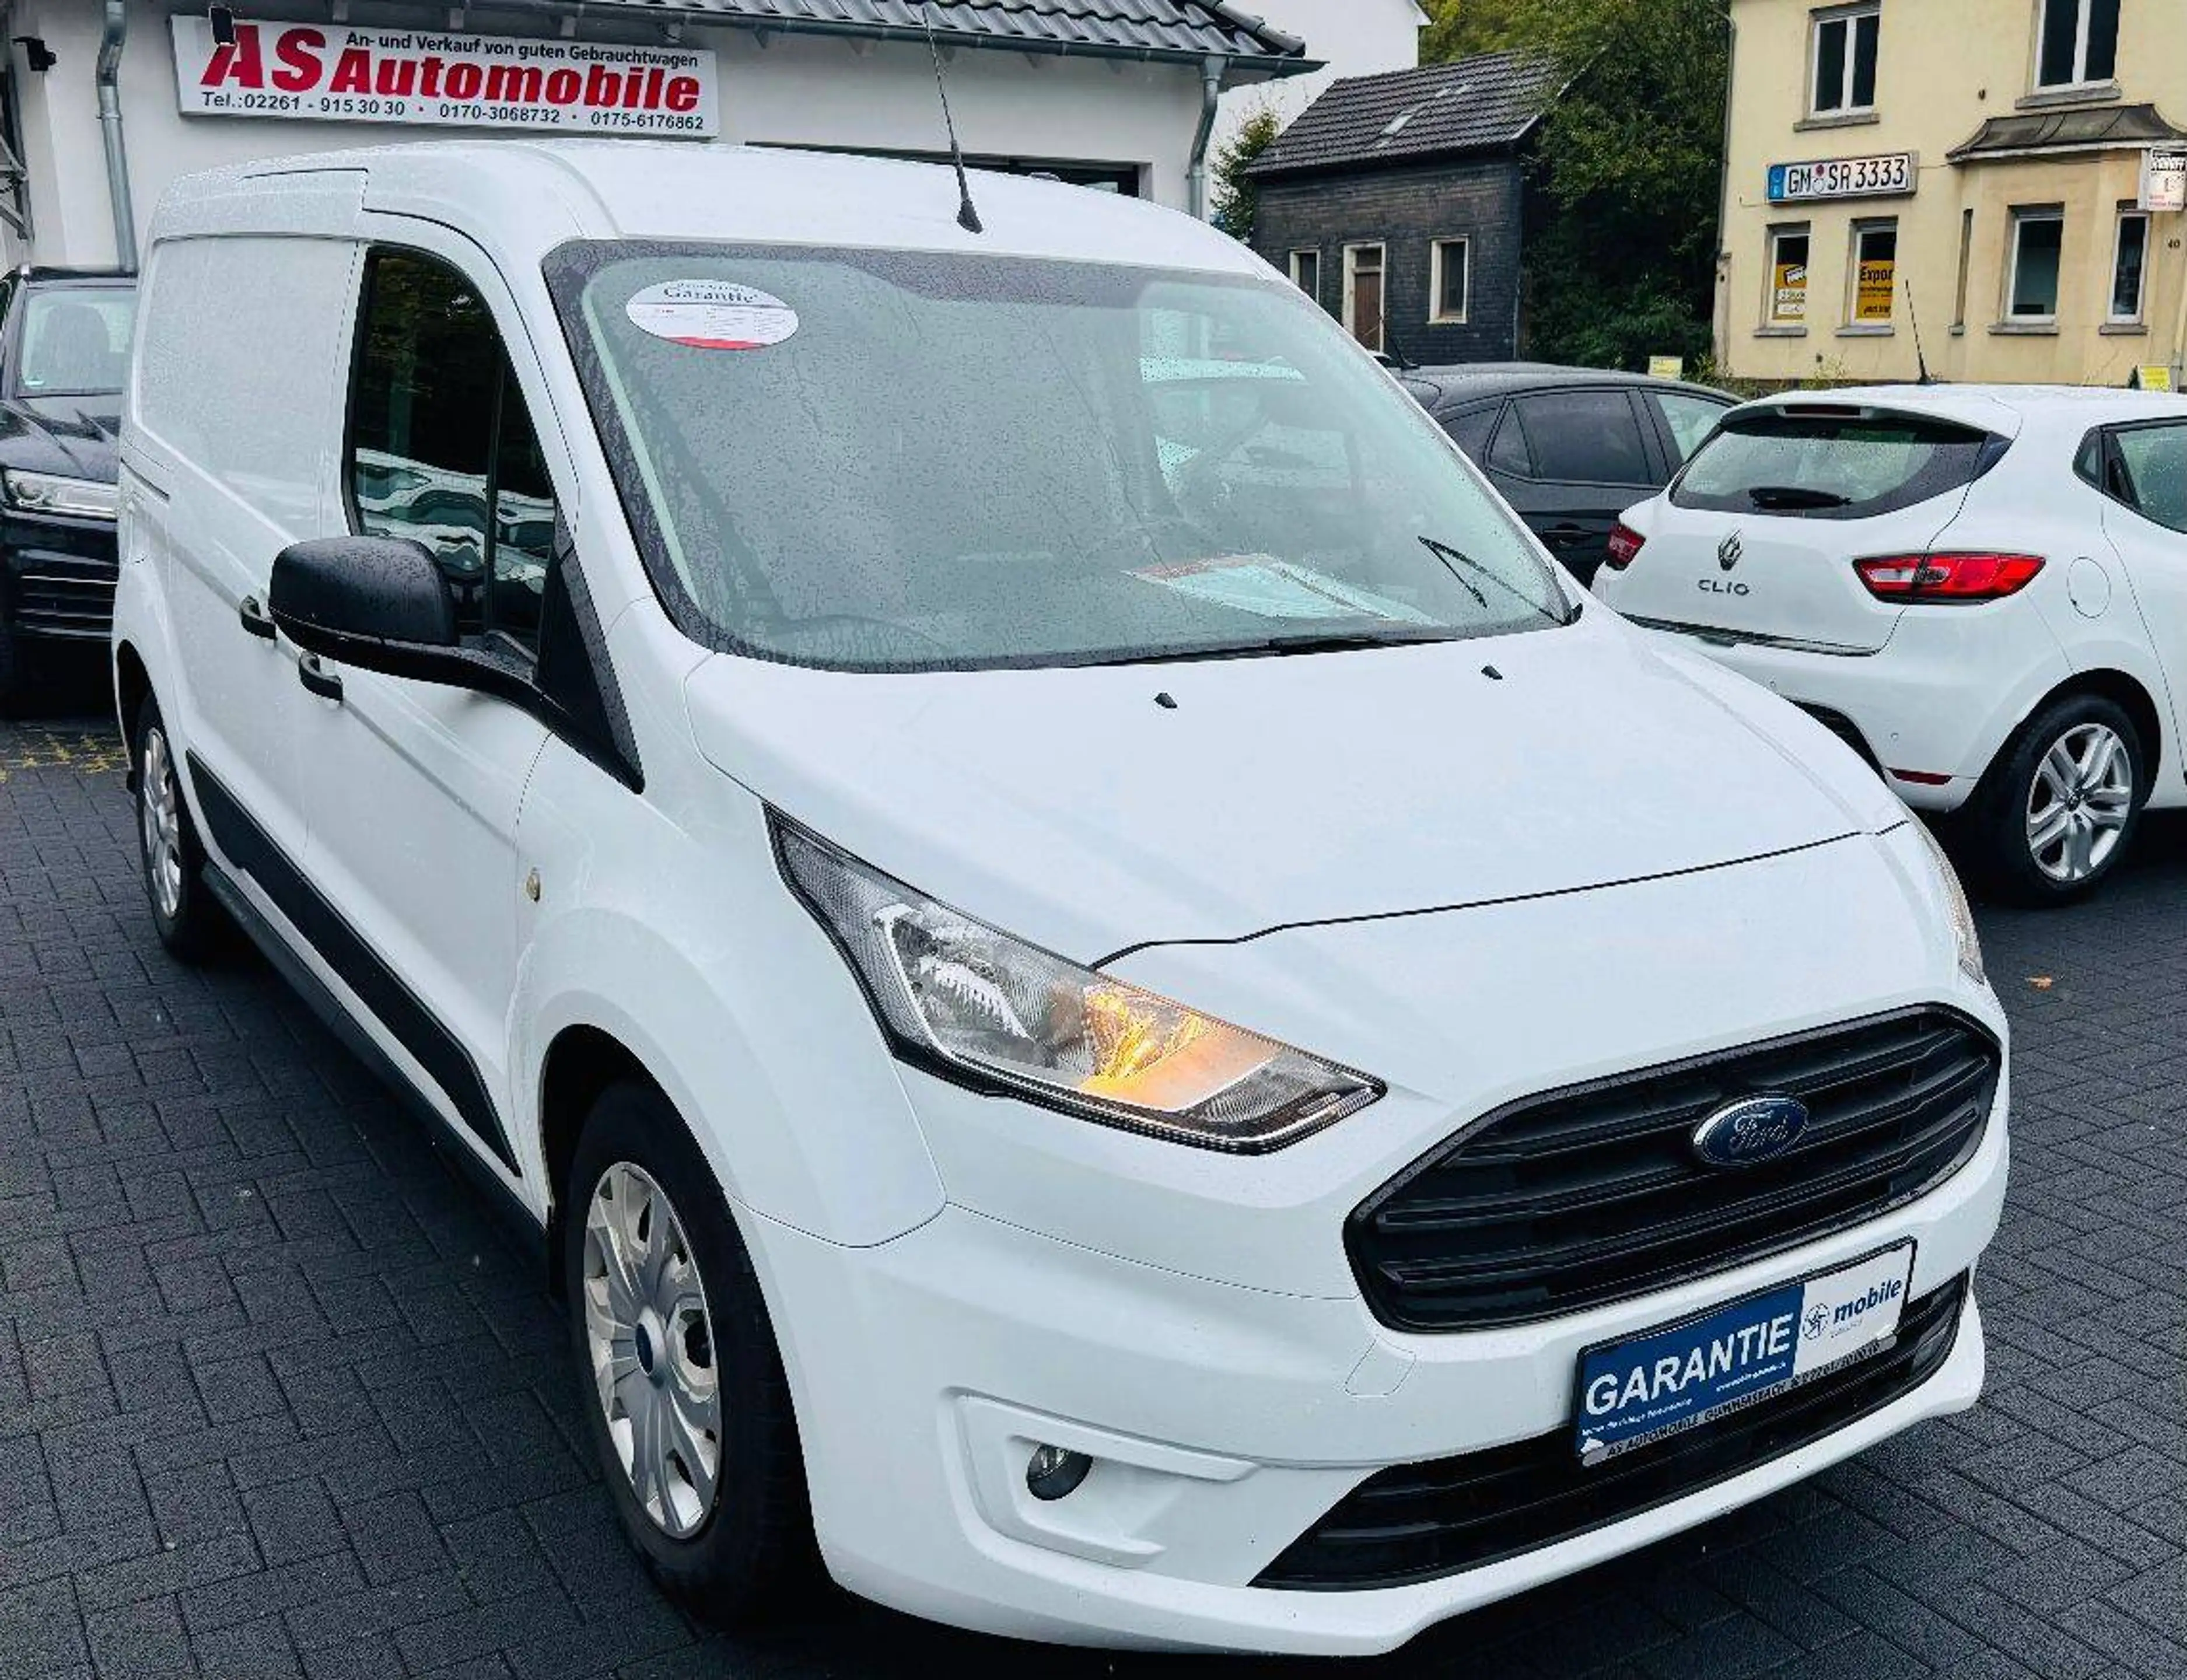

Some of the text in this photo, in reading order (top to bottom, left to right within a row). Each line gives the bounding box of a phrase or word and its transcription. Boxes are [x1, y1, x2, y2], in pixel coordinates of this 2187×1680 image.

[200, 24, 699, 111] AS Automobile
[346, 32, 698, 69] An- und Verkauf von guten Gebrauchtwagen
[321, 97, 354, 112] 915
[358, 99, 379, 114] 30
[384, 101, 405, 115] 30
[440, 104, 560, 123] 0170-3068732
[590, 111, 703, 130] 0175-6176862
[1788, 168, 1811, 194] GM
[1855, 158, 1905, 188] 3333
[1698, 579, 1749, 596] CLIO
[1833, 1279, 1902, 1324] mobile
[1586, 1312, 1794, 1415] GARANTIE
